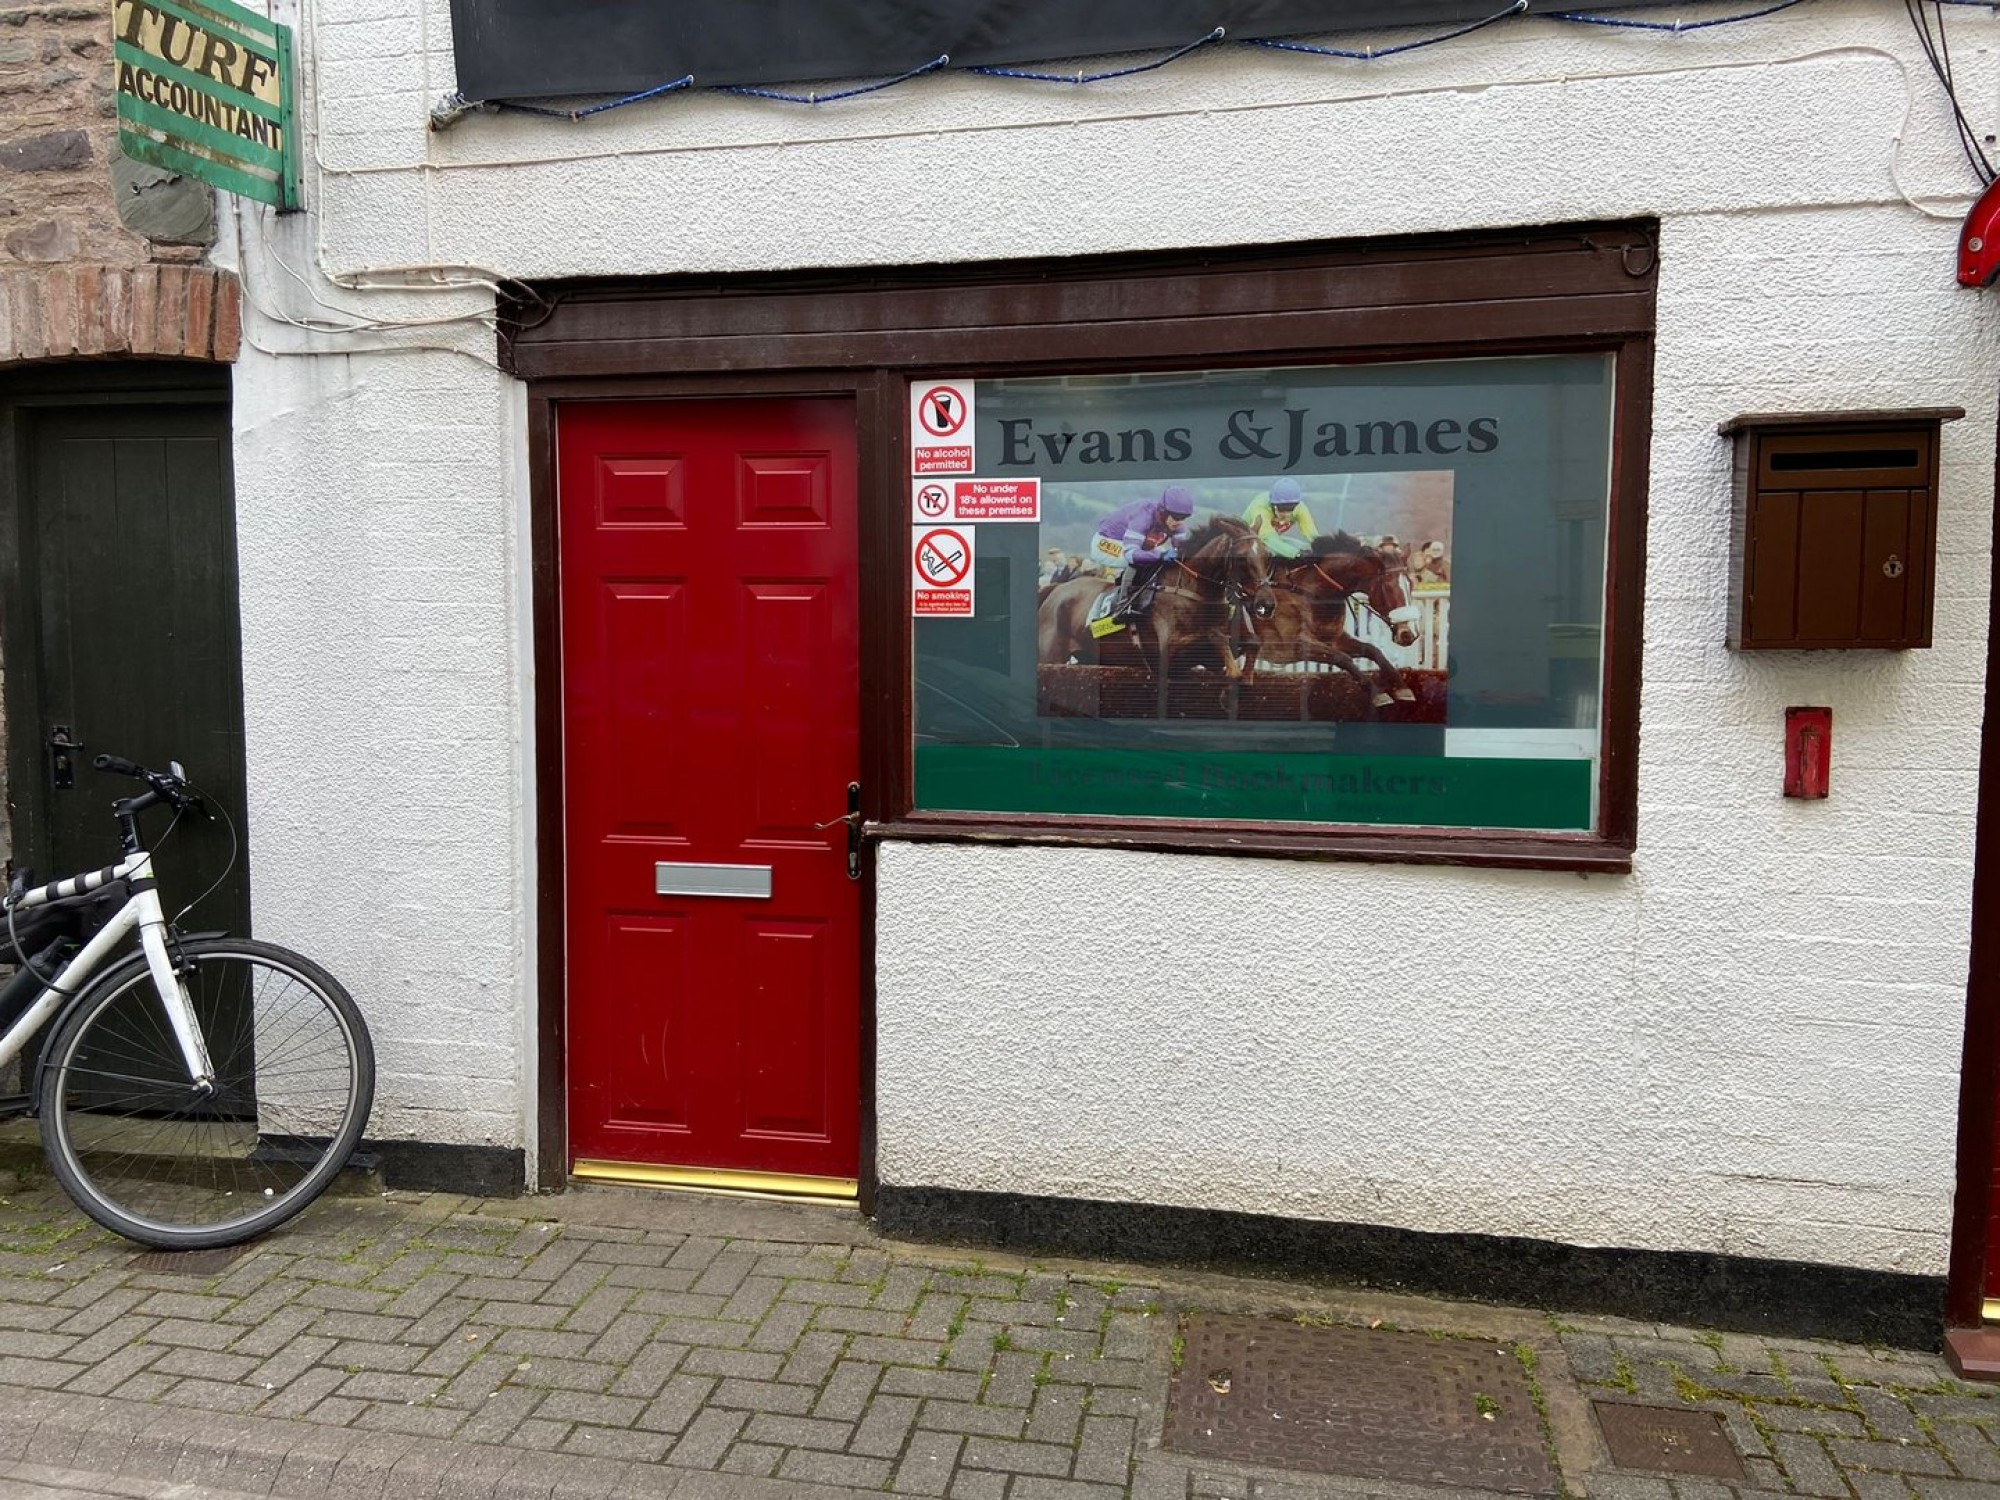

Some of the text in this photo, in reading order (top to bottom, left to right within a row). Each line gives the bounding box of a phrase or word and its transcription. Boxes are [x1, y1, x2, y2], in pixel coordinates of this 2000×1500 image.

[116, 0, 277, 97] TURF
[117, 60, 282, 150] ACCOUNTANT
[997, 417, 1193, 468] Evans
[916, 447, 971, 459] No alcohol
[919, 459, 968, 472] permitted
[972, 484, 1018, 493] No under
[979, 495, 1017, 505] allowed
[1019, 496, 1032, 504] on
[958, 506, 1033, 517] these premises
[916, 591, 970, 602] No smoking
[1200, 761, 1446, 796] Bookmakers
